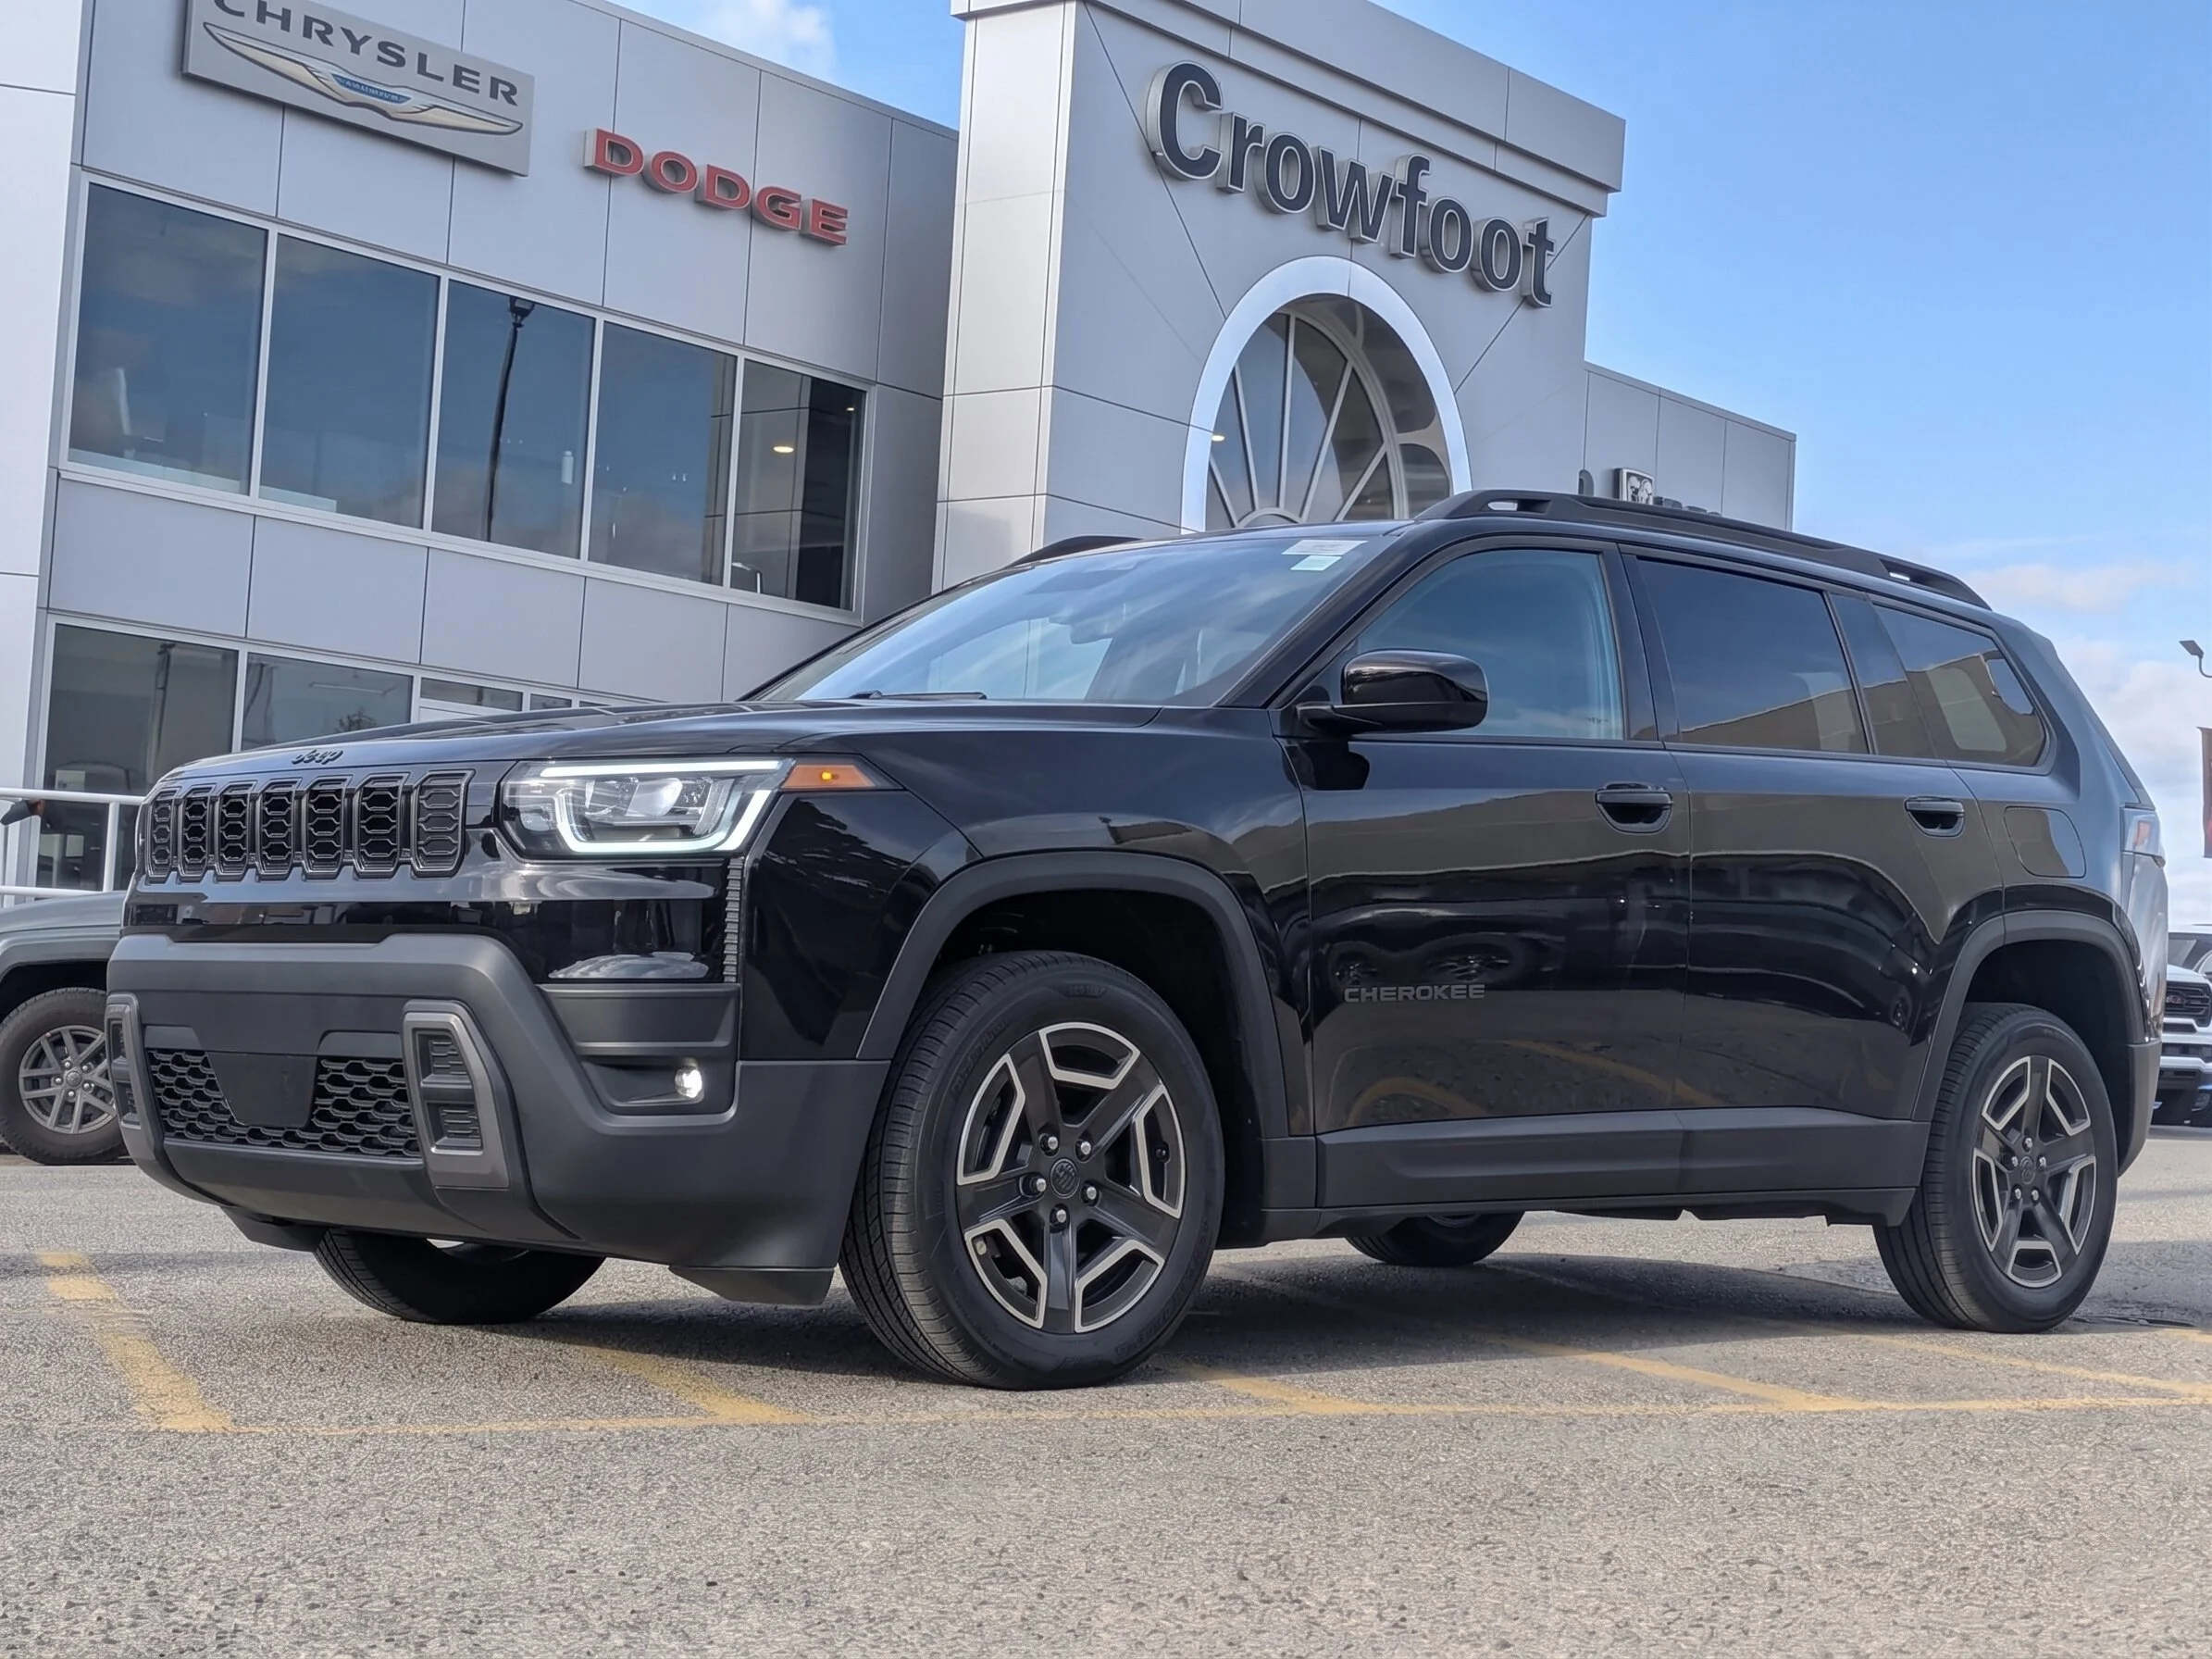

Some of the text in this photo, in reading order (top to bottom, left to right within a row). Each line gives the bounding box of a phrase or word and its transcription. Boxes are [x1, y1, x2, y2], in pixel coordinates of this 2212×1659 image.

[585, 128, 849, 245] DODGE
[1147, 60, 1556, 308] Crowfoot
[292, 749, 343, 765] Jeep
[1344, 984, 1485, 1003] CHEROKEE
